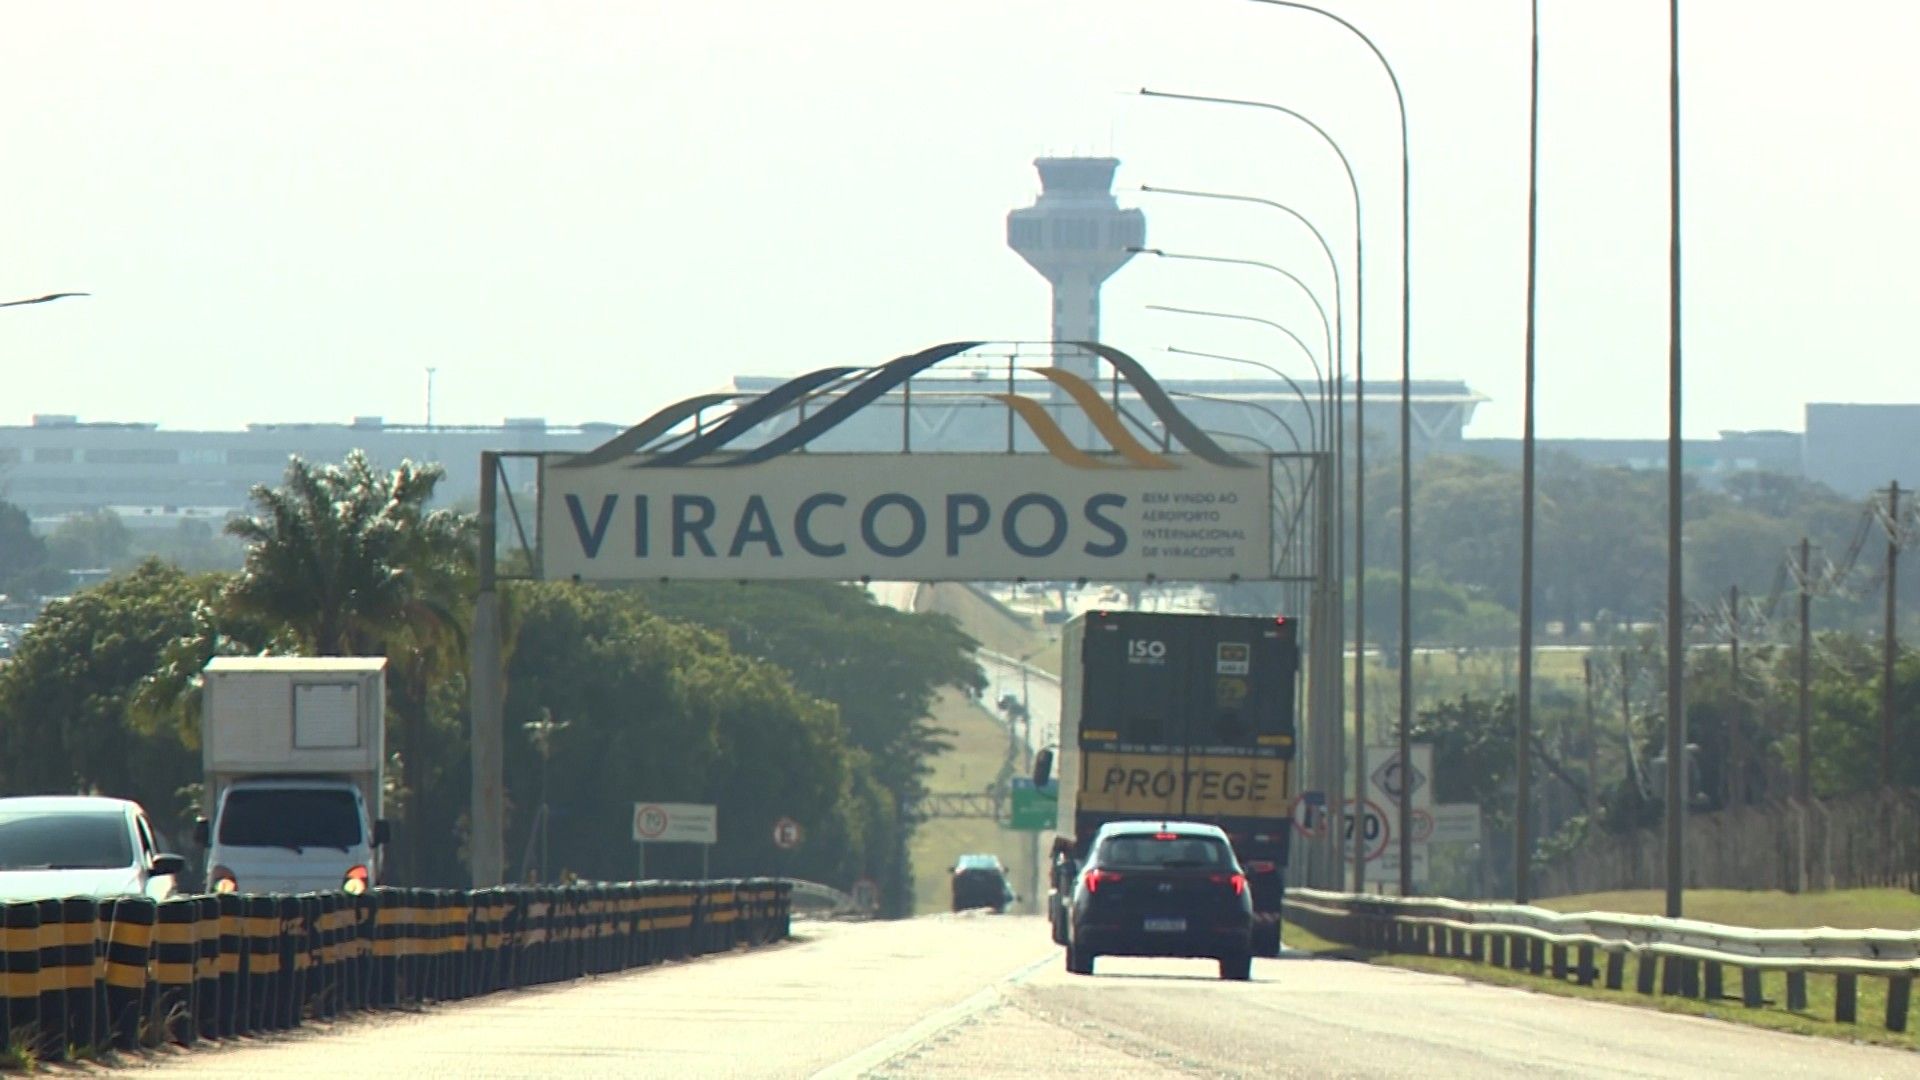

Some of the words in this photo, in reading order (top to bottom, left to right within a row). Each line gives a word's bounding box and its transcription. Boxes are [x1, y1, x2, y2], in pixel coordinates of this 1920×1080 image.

[1142, 492, 1169, 503] BEM
[1173, 492, 1216, 504] VINDO
[1218, 491, 1238, 504] AO
[1142, 510, 1220, 521] AEROPORTO
[564, 493, 1128, 558] VIRACOPOS
[1142, 528, 1246, 540] INTERNACIONAL
[1142, 546, 1159, 557] DE
[1162, 546, 1235, 557] VIRACOPOS
[1128, 639, 1167, 657] ISO
[1103, 765, 1271, 802] PROTEGE
[1344, 813, 1380, 840] 70
